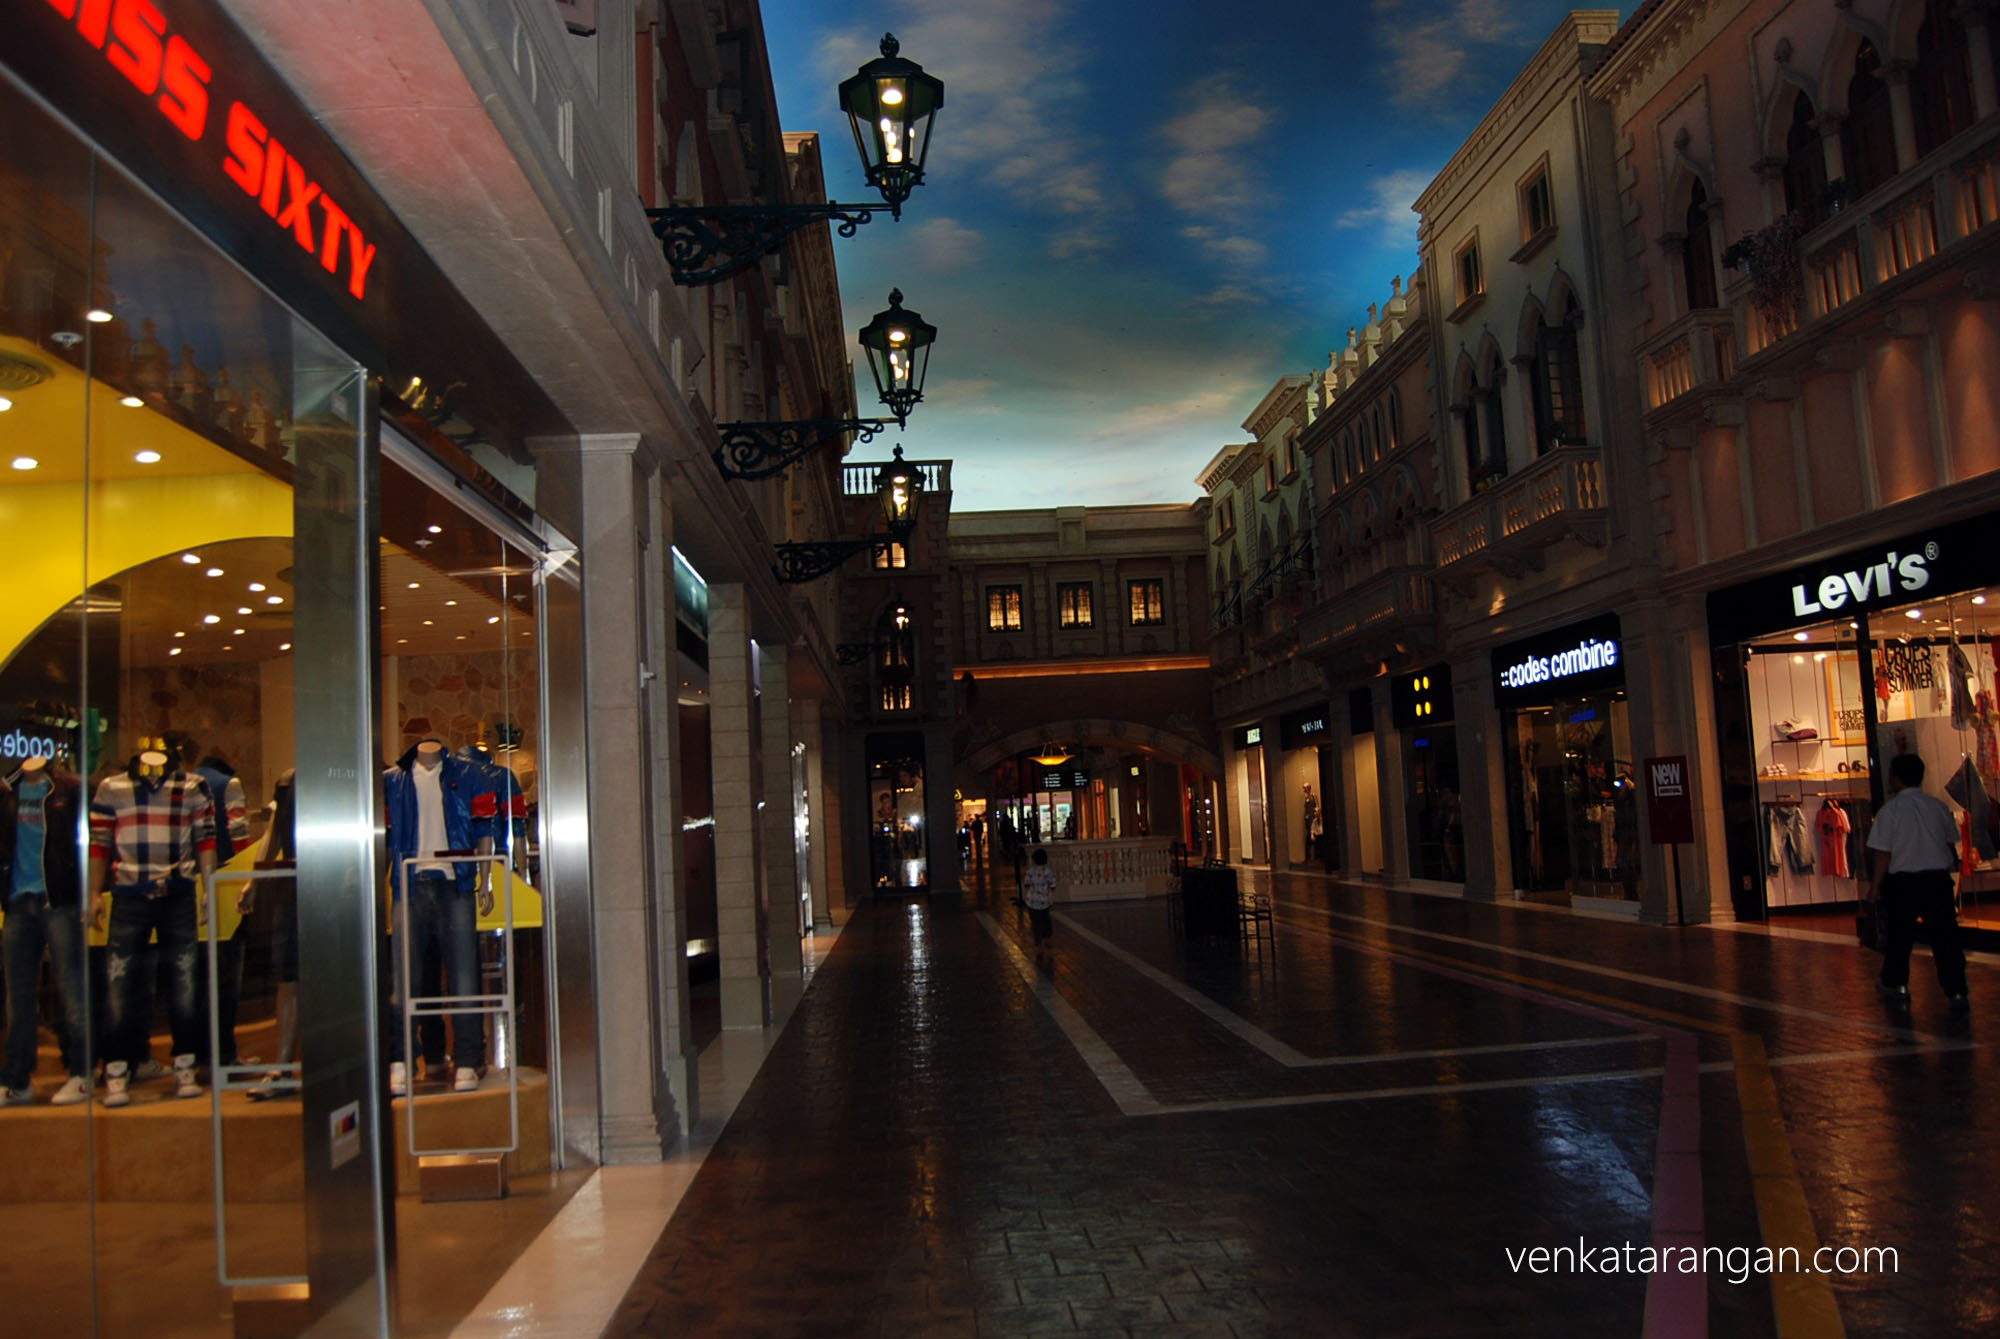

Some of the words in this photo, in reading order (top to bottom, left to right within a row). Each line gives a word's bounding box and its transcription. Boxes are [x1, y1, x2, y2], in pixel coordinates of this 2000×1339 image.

[223, 101, 376, 300] SIXTY
[1551, 638, 1618, 678] combine
[1885, 643, 1931, 665] CROPS
[1889, 673, 1934, 693] SUMMER
